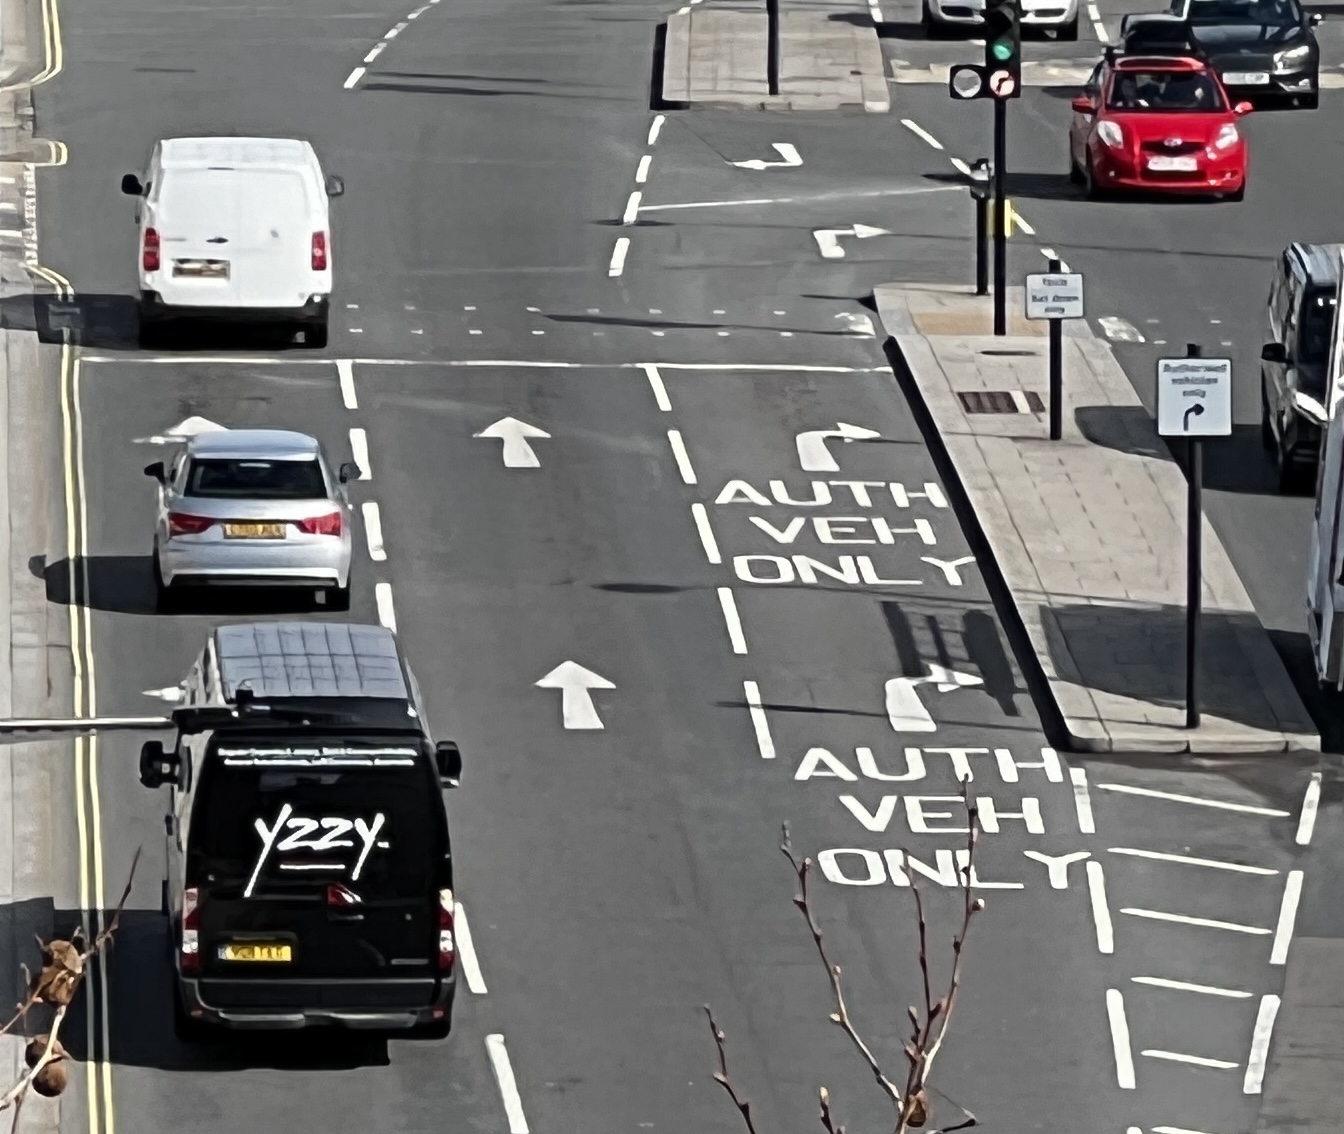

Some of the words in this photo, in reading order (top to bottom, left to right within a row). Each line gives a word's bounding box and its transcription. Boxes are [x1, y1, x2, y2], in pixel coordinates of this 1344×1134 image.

[714, 480, 949, 508] AUTH
[748, 516, 937, 545] VEH
[733, 554, 976, 586] ONLY
[794, 747, 1064, 783] AUTH
[838, 795, 1045, 834] VEH
[817, 848, 1092, 889] ONLY
